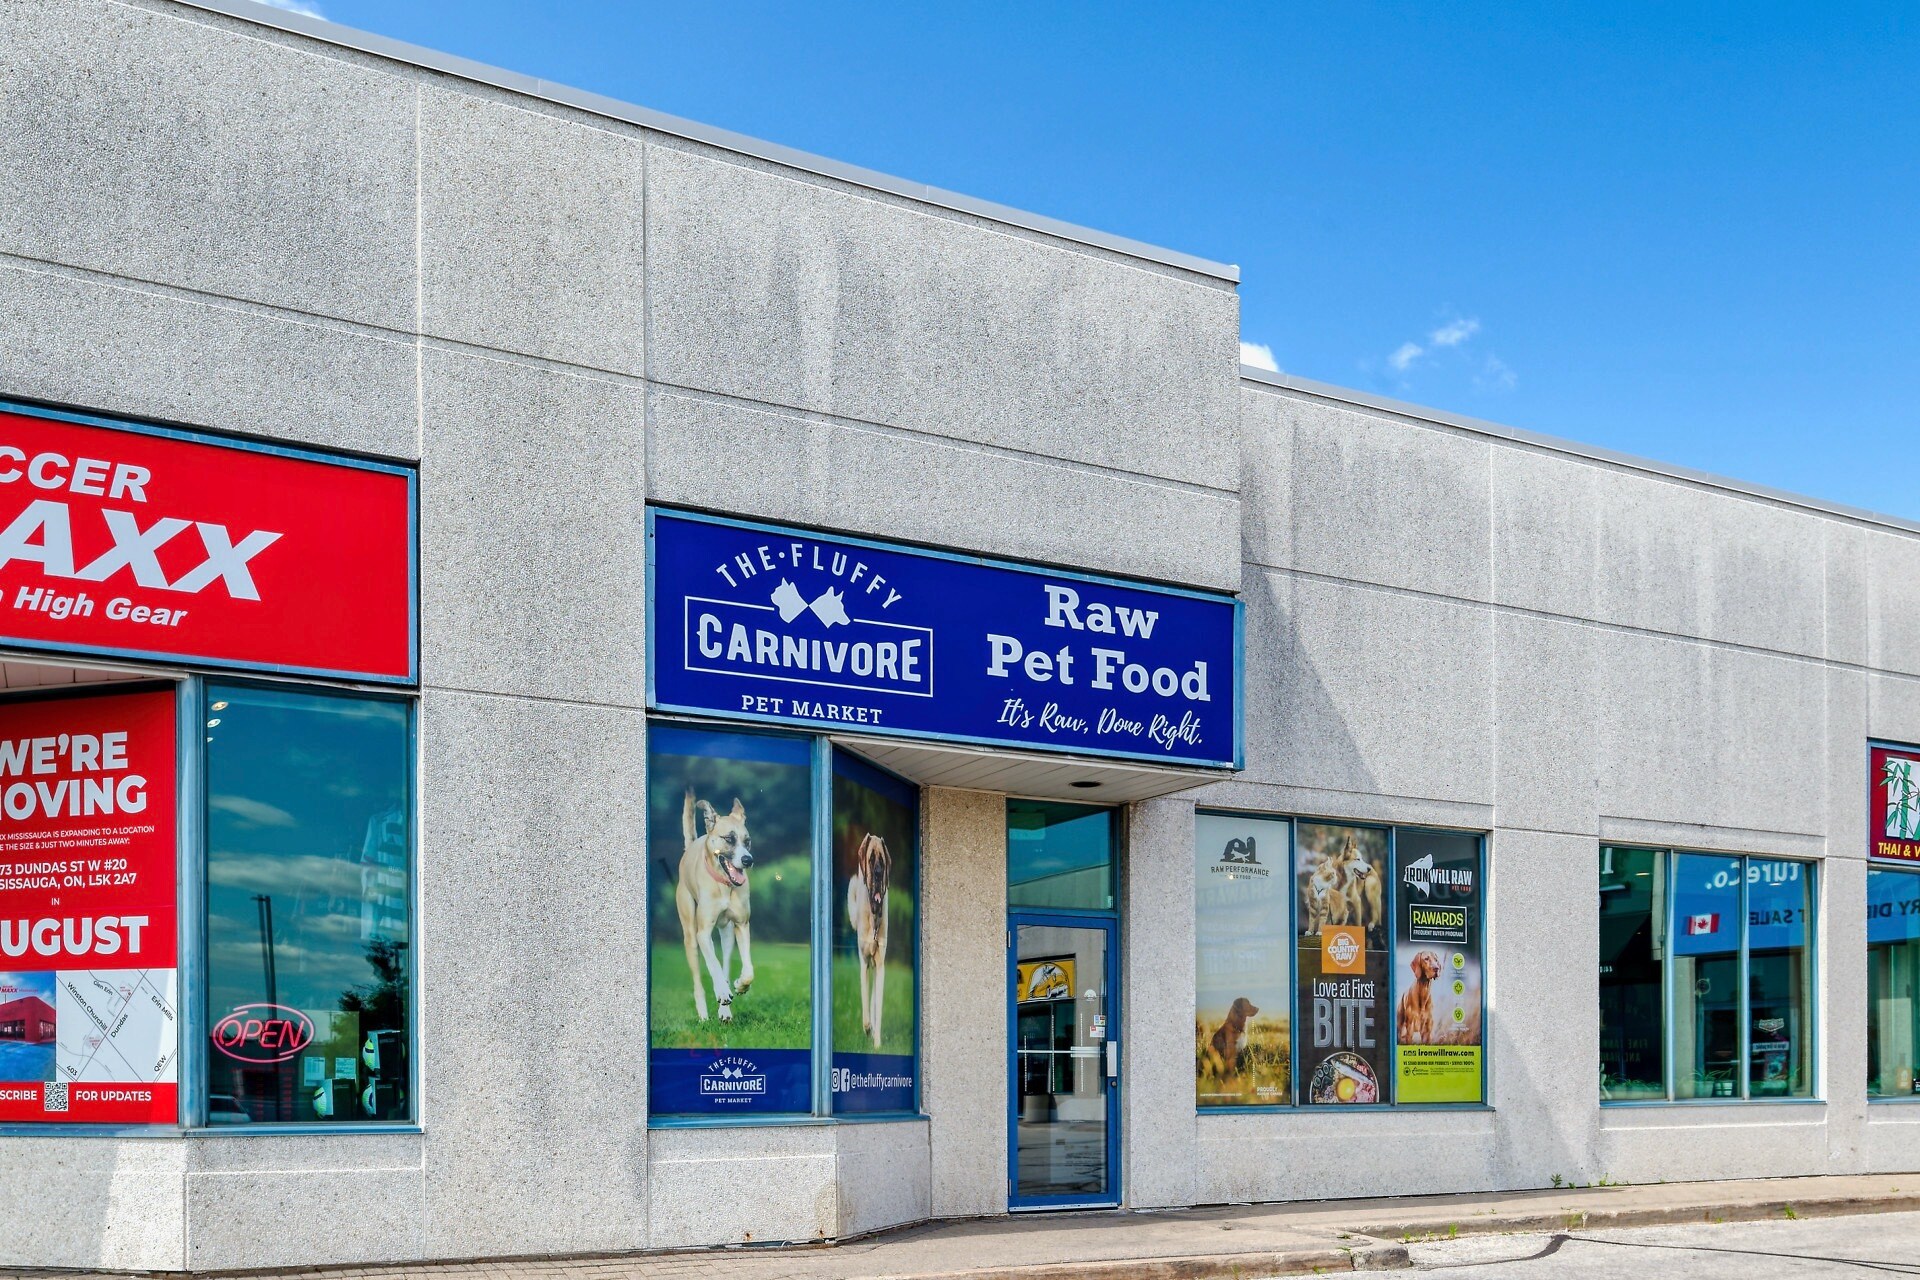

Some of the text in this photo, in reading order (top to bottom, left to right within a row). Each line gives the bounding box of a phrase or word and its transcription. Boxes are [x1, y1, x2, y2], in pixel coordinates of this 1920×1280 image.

[716, 543, 902, 609] THE FLUFFY
[13, 586, 188, 627] High Gear
[1044, 584, 1159, 639] Raw
[697, 613, 922, 682] CARNIVORE
[986, 633, 1211, 702] Pet Food
[741, 694, 883, 724] PET MARKET
[996, 698, 1203, 751] It's Raw, Done Right.
[0, 731, 128, 777] WE'RE
[0, 775, 147, 820] OVING
[8, 831, 52, 840] MISSISSAUGA
[53, 830, 60, 838] IS
[60, 828, 100, 838] EXPANDING
[102, 827, 112, 835] TO
[120, 825, 154, 834] LOCATION
[5, 842, 18, 850] THE
[20, 842, 34, 850] SIZE
[35, 841, 40, 849] &
[41, 840, 58, 849] JUST
[59, 840, 76, 848] TWO
[76, 838, 107, 847] MINUTES
[108, 837, 130, 845] AWAY:
[1878, 842, 1901, 856] THAI
[1903, 845, 1912, 857] &
[15, 861, 68, 875] DUNDAS
[70, 860, 85, 872] ST
[88, 860, 102, 872] W
[104, 858, 128, 871] #20
[1210, 866, 1270, 877] RAW PERFORMANCE
[64, 875, 86, 888] ON,
[89, 874, 112, 886] L5K
[114, 872, 137, 885] 2A7
[1407, 867, 1429, 882] IRON
[1451, 870, 1472, 886] RAW
[51, 898, 60, 906] IN
[1413, 911, 1464, 926] RAWARDS
[1328, 945, 1360, 954] COUNTRY
[104, 986, 114, 996] Erin
[1314, 978, 1375, 999] Love at First
[67, 982, 87, 1008] Winston
[86, 1005, 108, 1032] Churchill
[151, 995, 174, 1021] Erin Mills
[110, 1013, 129, 1038] Dundas
[1314, 998, 1376, 1048] BITE
[218, 1018, 305, 1048] OPEN
[1418, 1048, 1474, 1056] ironwillraw.com
[66, 1065, 78, 1076] 403
[153, 1055, 167, 1072] QEW
[708, 1056, 758, 1072] THE FLUFFY
[703, 1077, 763, 1091] CARNIVORE
[850, 1072, 912, 1091] @thefluffycarnivore
[75, 1090, 98, 1101] FOR
[100, 1090, 152, 1102] UPDATES
